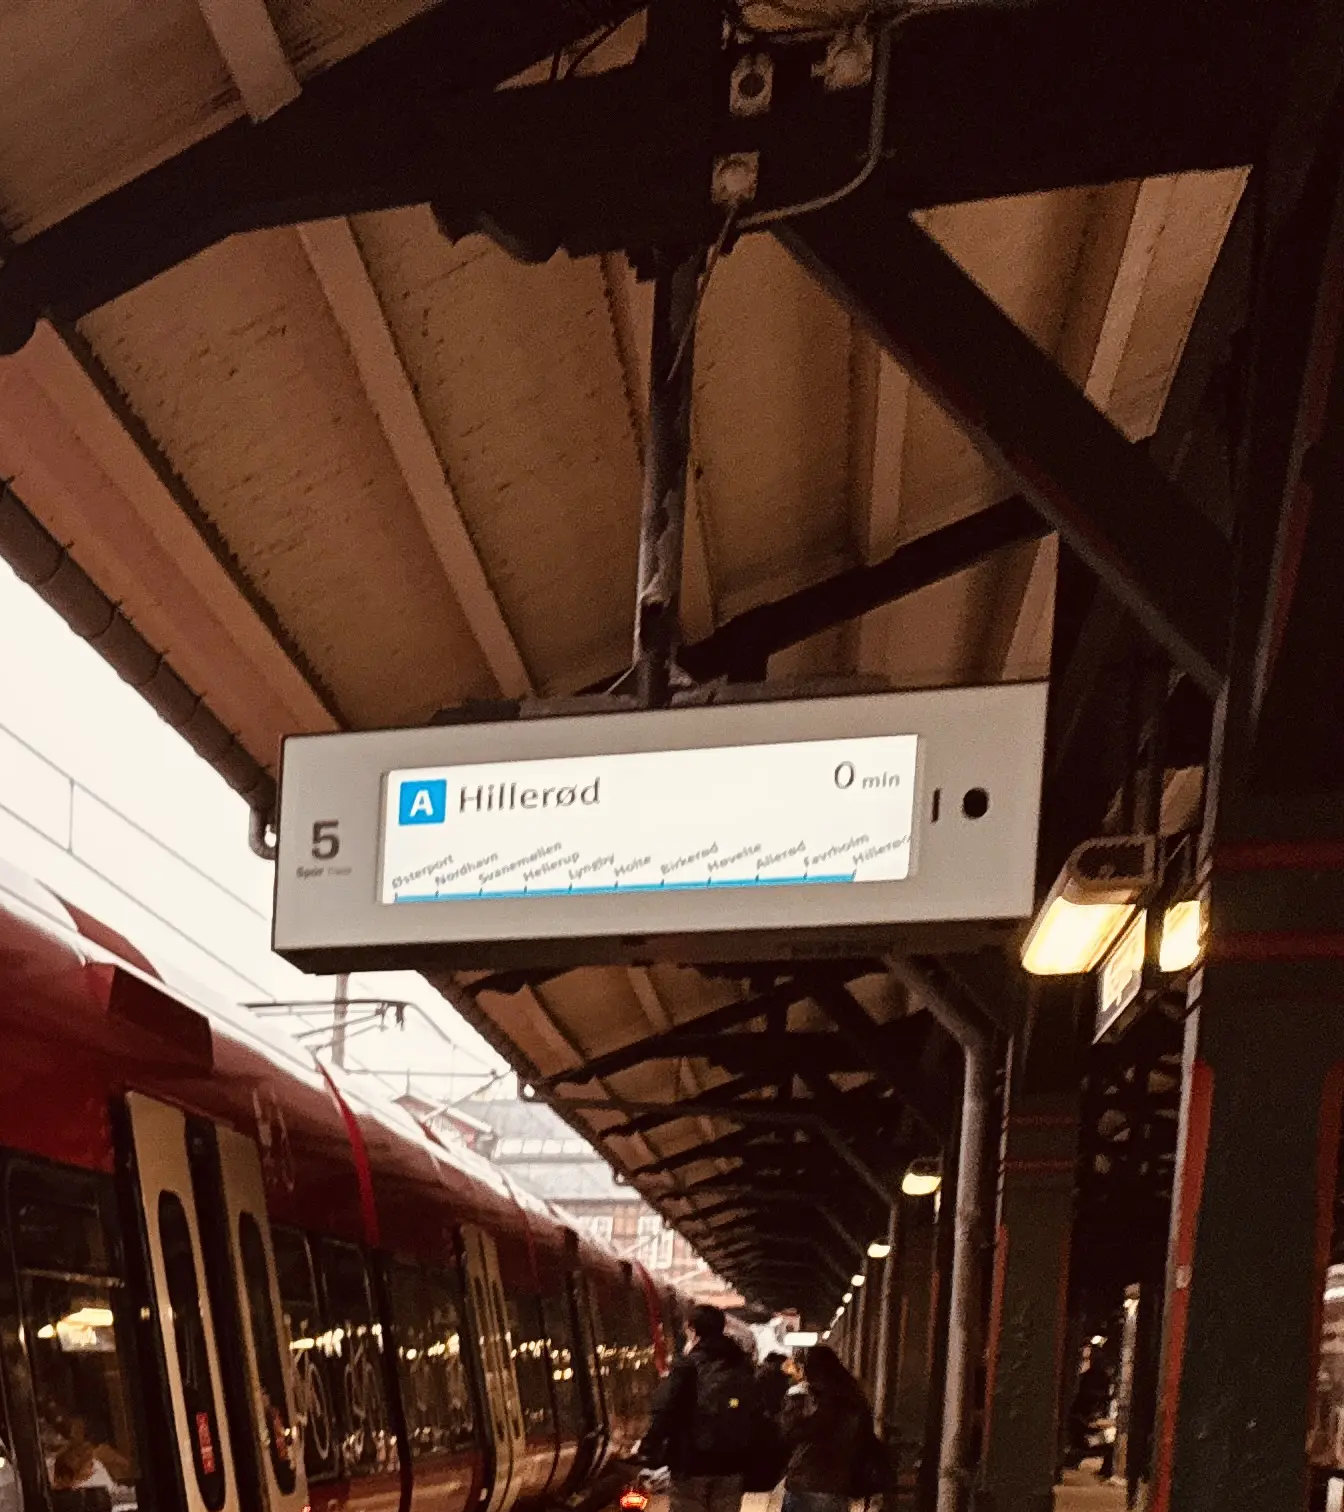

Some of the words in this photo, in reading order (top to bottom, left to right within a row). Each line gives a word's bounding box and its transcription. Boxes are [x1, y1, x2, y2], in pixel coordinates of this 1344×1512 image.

[834, 761, 855, 790] 0
[862, 770, 901, 789] min
[409, 790, 434, 817] A
[459, 776, 601, 813] Hillerød
[311, 818, 340, 861] 5
